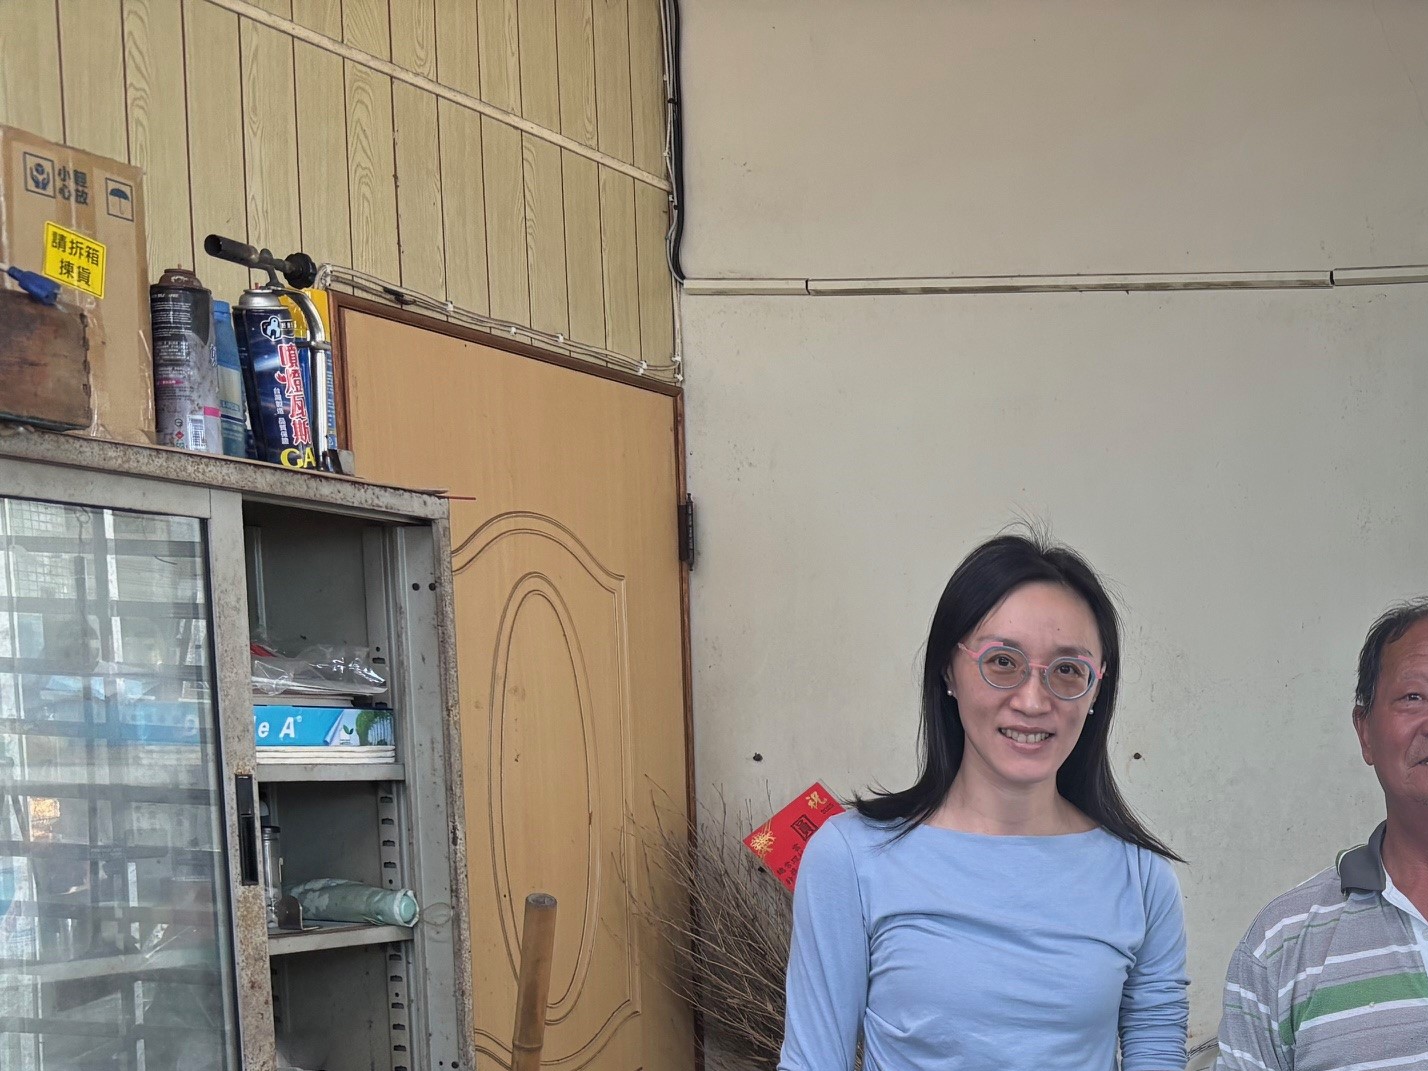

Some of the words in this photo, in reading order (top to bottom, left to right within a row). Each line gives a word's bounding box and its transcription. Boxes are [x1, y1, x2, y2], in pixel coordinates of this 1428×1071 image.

[51, 231, 100, 267] 請拆箱
[58, 258, 91, 287] 揀貨
